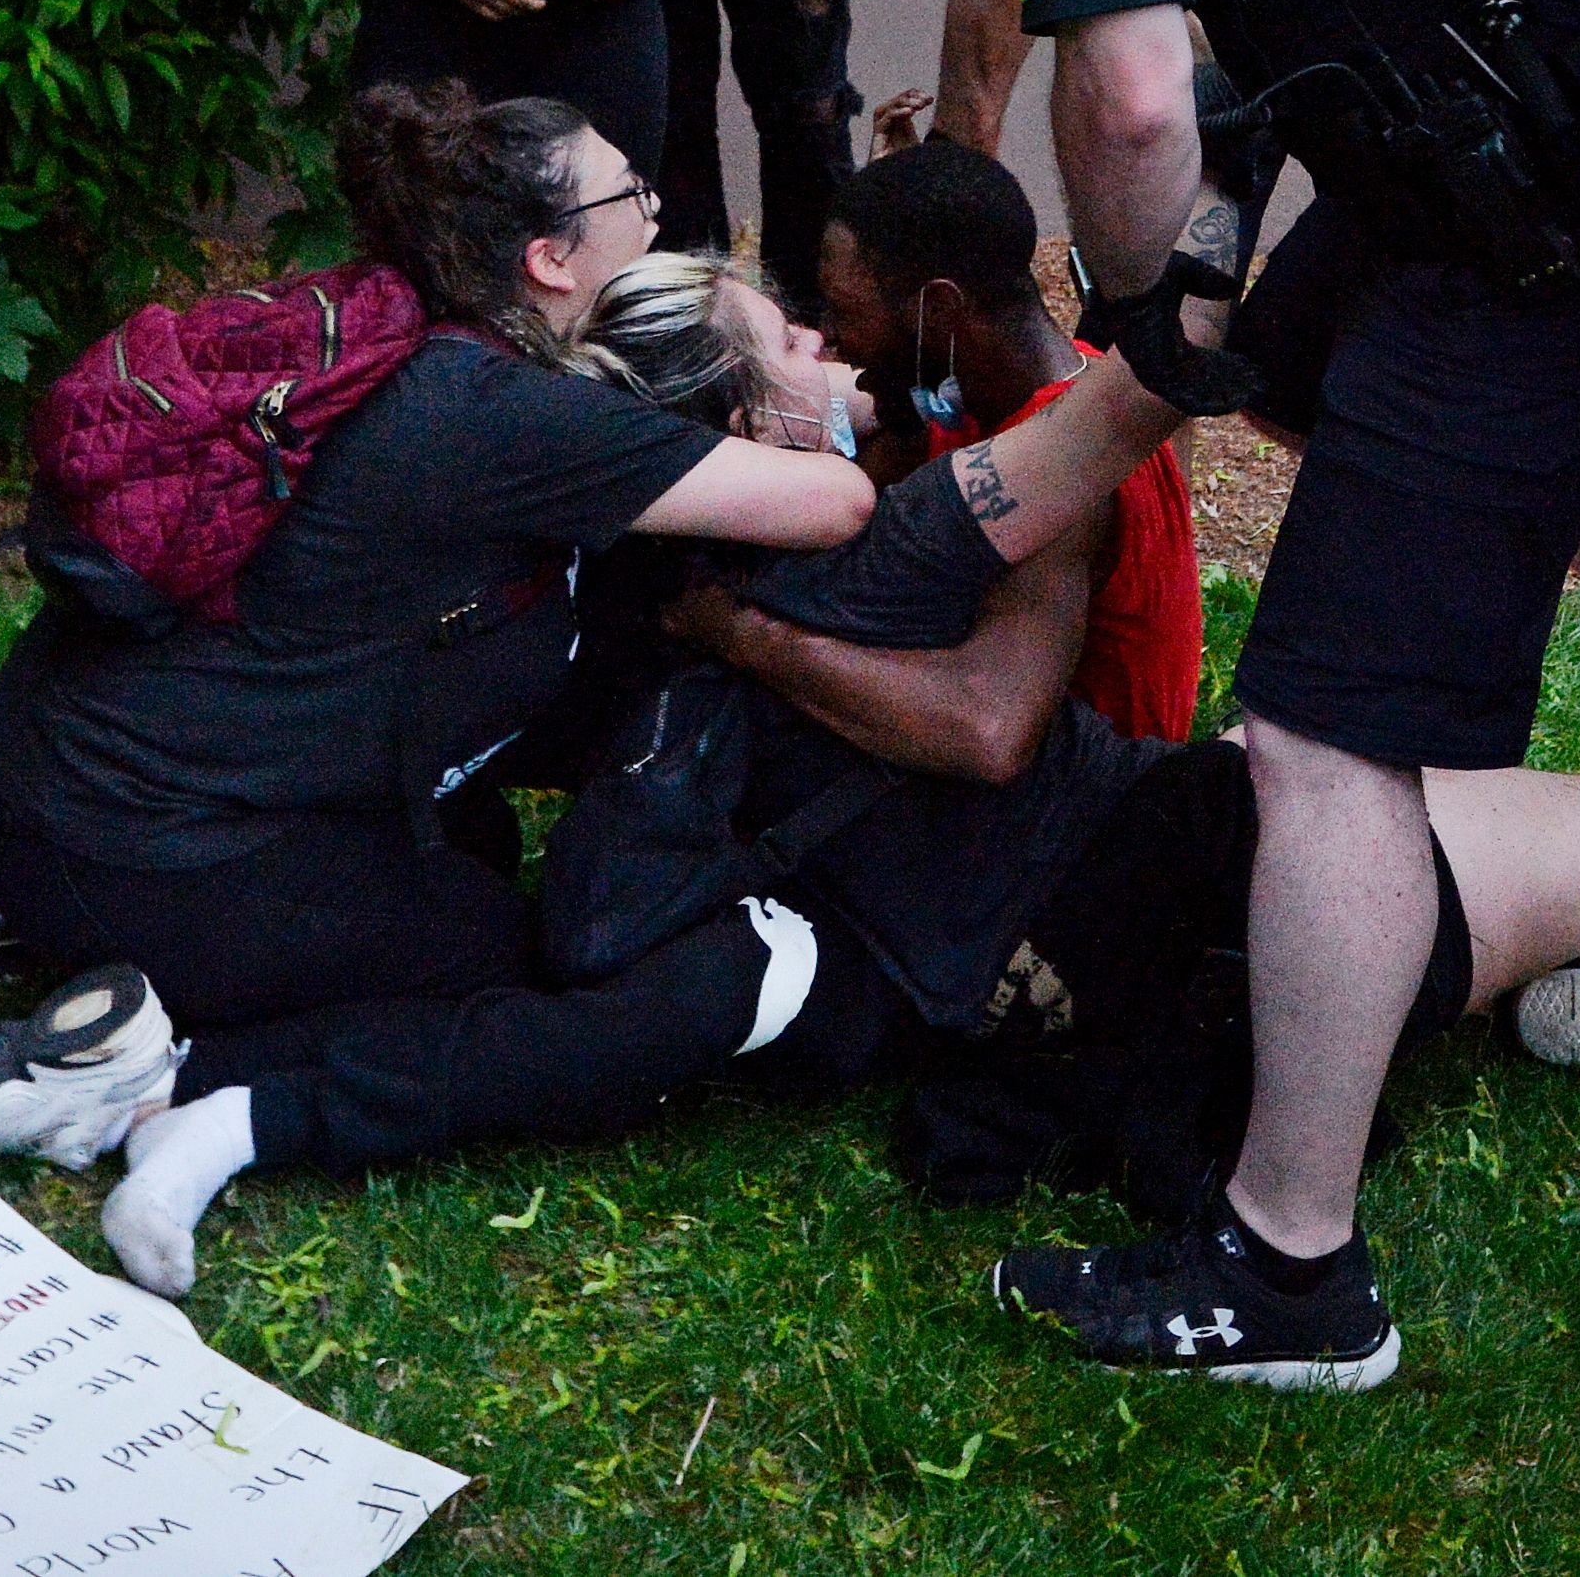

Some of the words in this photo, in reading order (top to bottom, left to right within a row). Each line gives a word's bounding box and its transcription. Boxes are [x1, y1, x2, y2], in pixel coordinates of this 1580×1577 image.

[77, 1352, 162, 1396] the
[40, 1475, 78, 1495] a
[228, 1447, 332, 1503] the
[356, 1482, 421, 1544] IF
